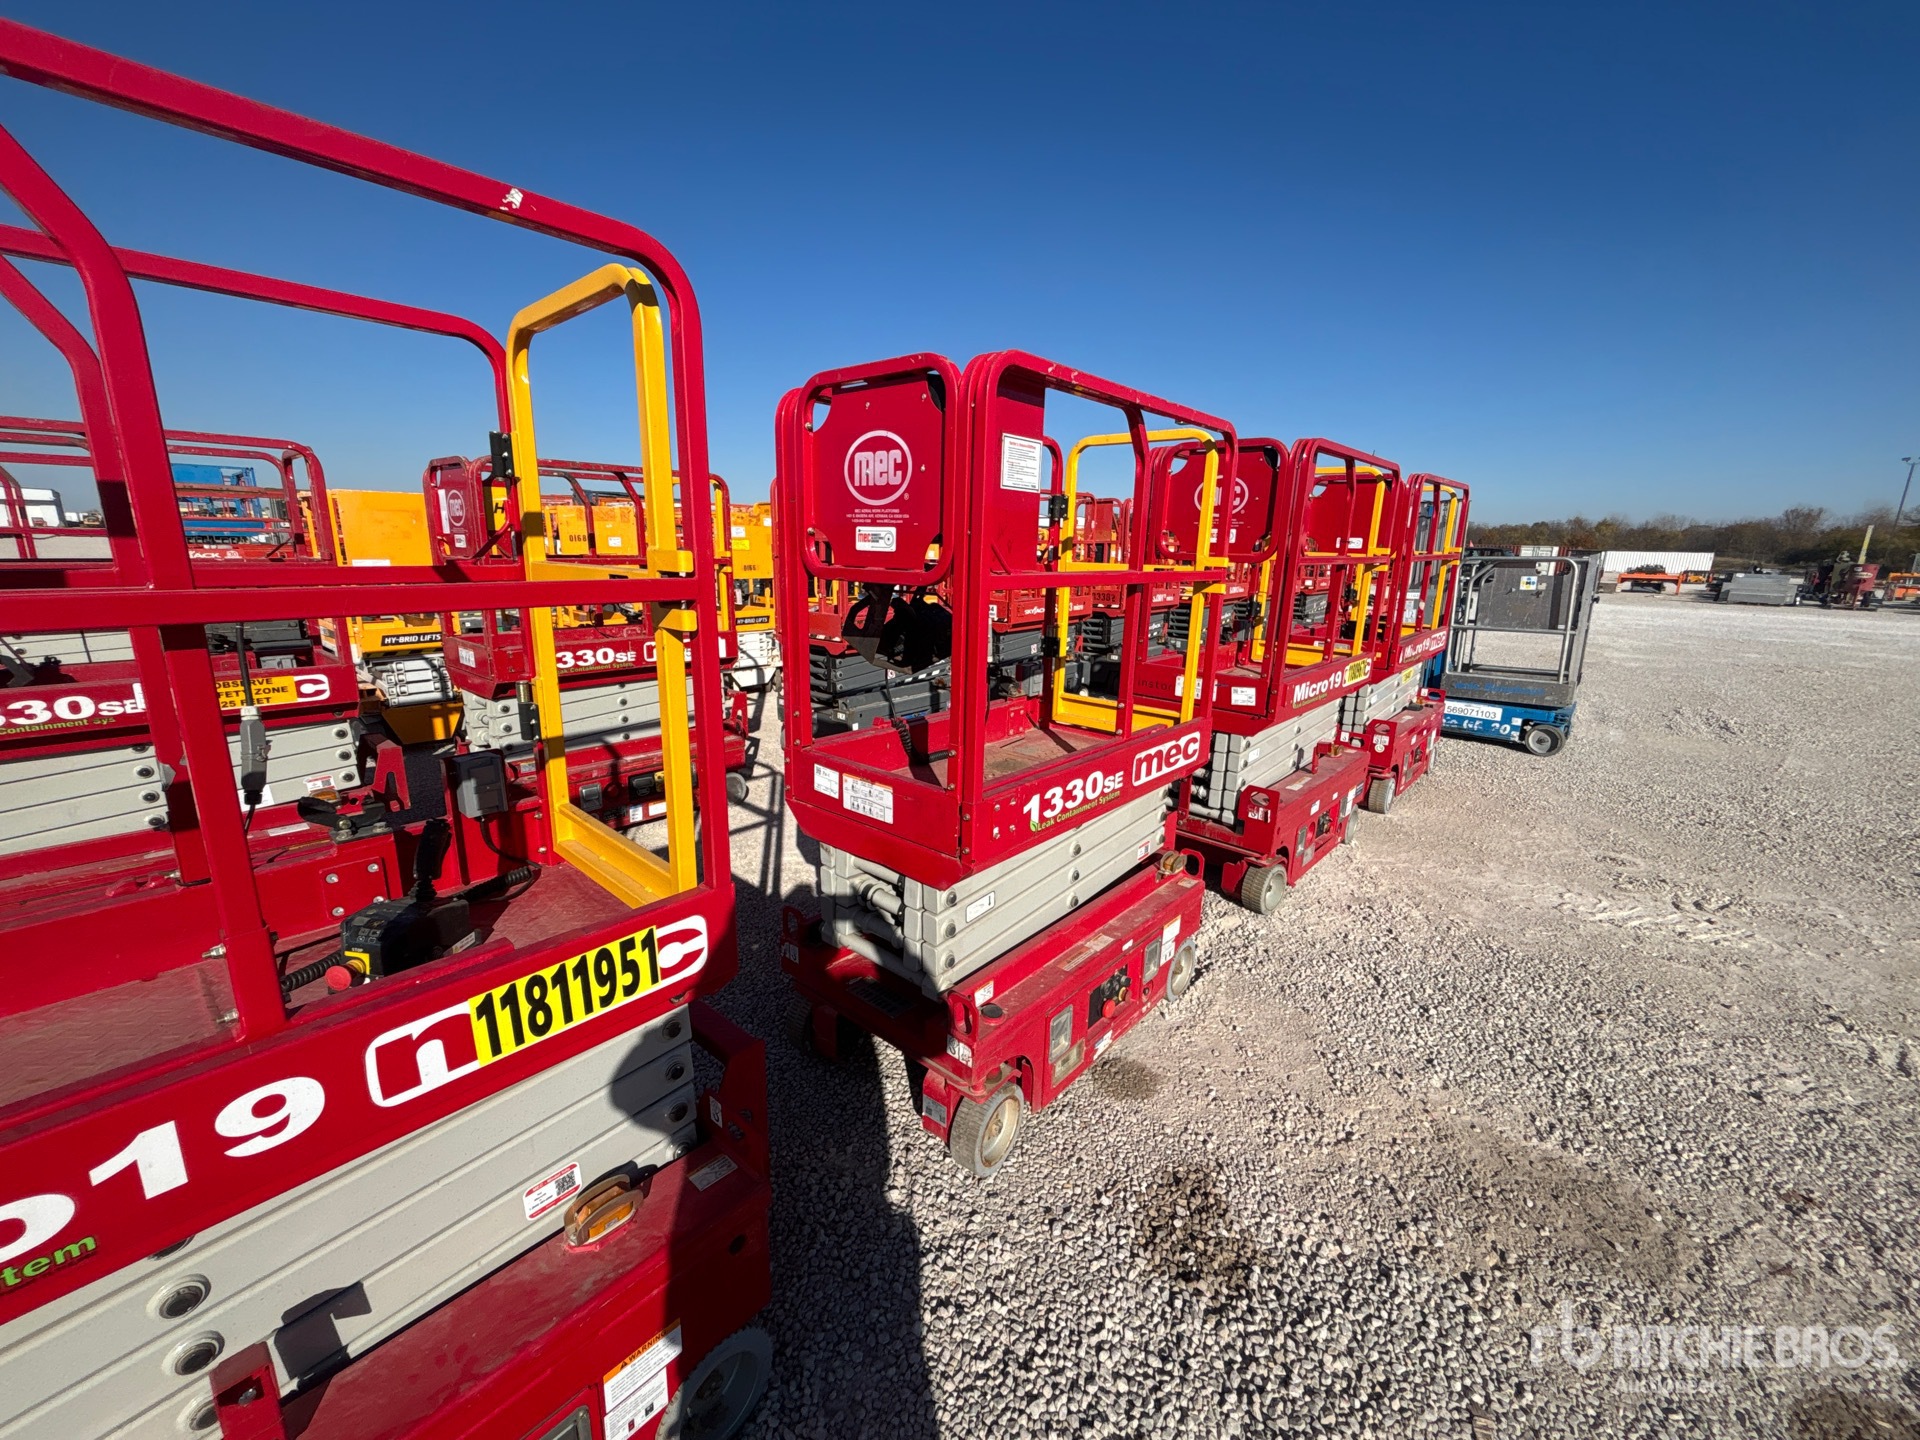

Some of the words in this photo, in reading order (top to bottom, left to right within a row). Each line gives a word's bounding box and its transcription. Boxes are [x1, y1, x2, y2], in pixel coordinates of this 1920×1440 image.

[384, 635, 419, 645] HY-BRID
[420, 633, 442, 642] LIFTS
[254, 686, 289, 696] ZONE
[1293, 671, 1342, 703] Micro19
[221, 700, 237, 709] 25
[1446, 705, 1497, 720] 569071103
[1023, 770, 1124, 825] 1330SE
[1037, 818, 1055, 832] Leak
[1056, 799, 1098, 822] Containment
[1098, 790, 1121, 805] System
[475, 927, 660, 1059] 11811951
[628, 1329, 668, 1362] WARNING
